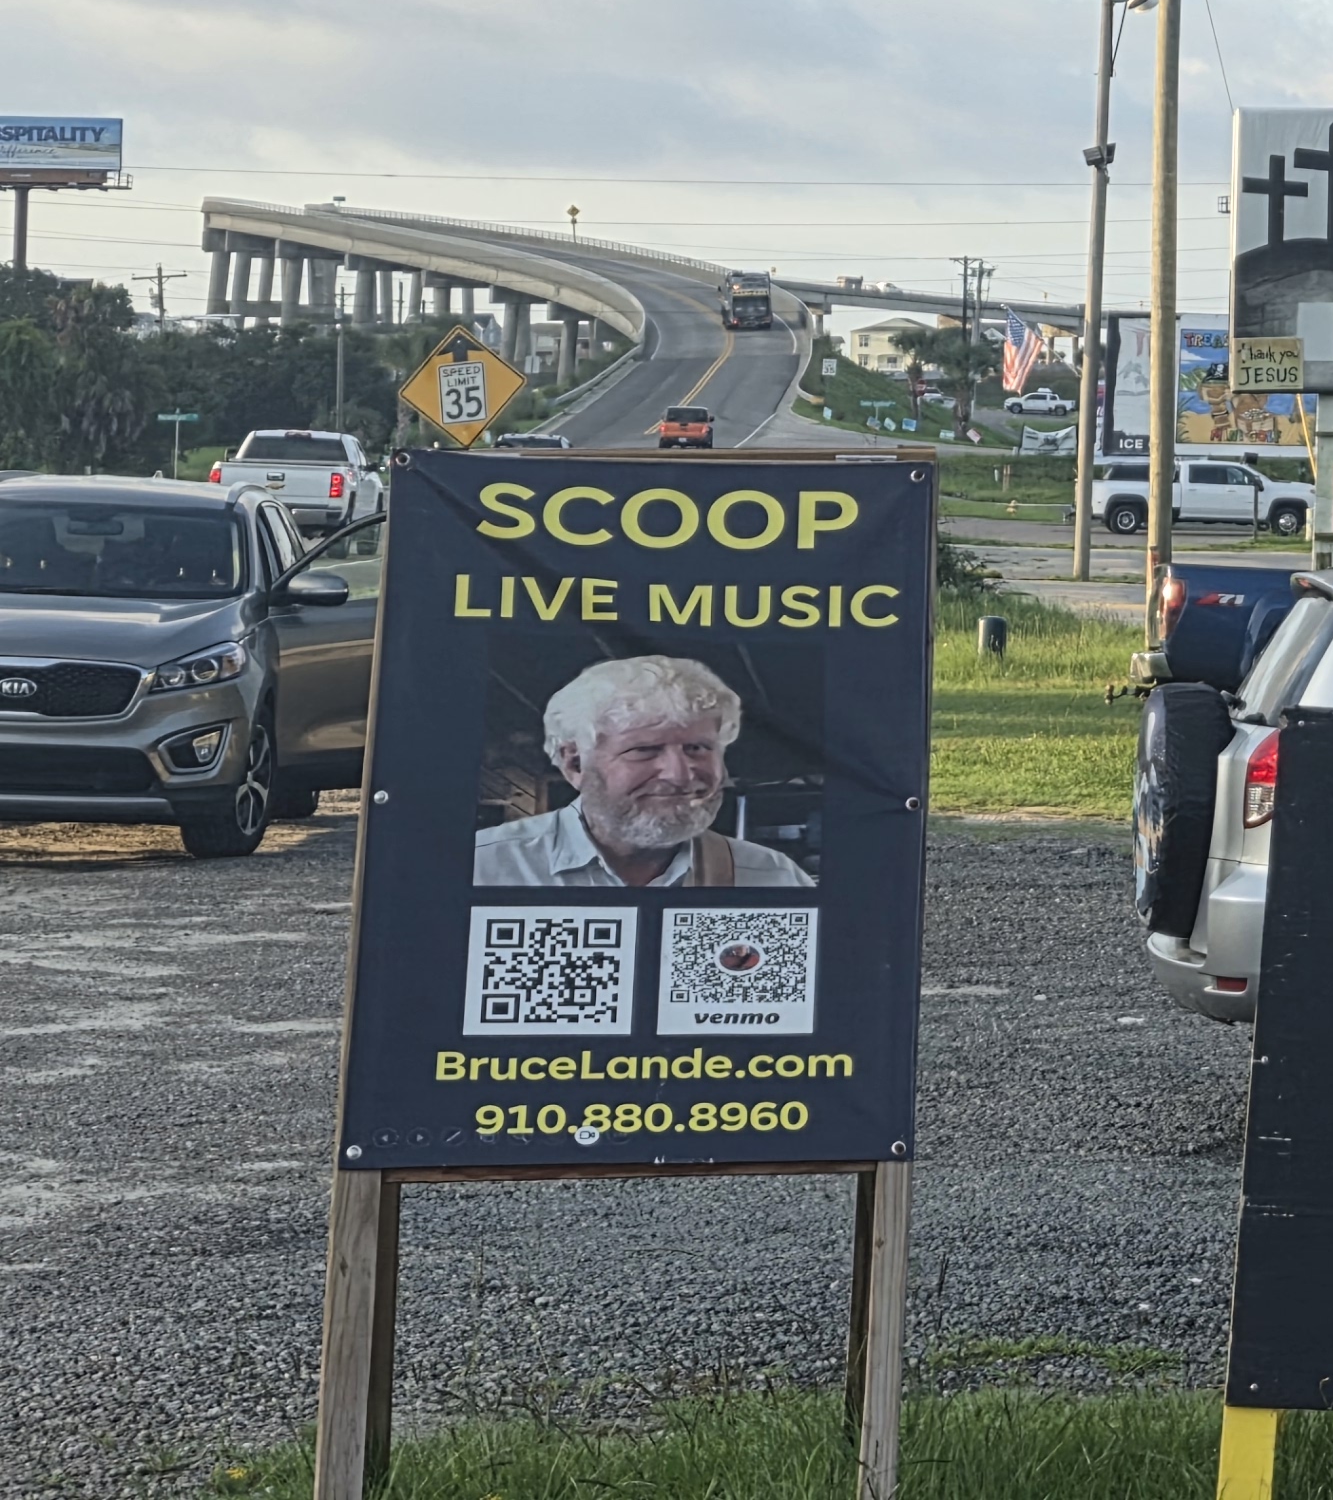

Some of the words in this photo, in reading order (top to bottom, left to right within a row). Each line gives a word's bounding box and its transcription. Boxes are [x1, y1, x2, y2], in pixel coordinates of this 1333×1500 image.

[442, 365, 481, 378] SPEED
[1238, 366, 1298, 386] JESUS
[447, 376, 477, 388] LIMIT
[445, 386, 483, 420] 35
[1119, 438, 1144, 449] ICE
[475, 481, 860, 551] SCOOP
[453, 573, 619, 623] LIVE
[647, 583, 902, 629] MUSIC
[1, 681, 30, 695] KIA
[693, 1011, 780, 1025] venmo
[434, 1047, 855, 1083] BruceLande.com
[473, 1099, 810, 1137] 910.880.8960
